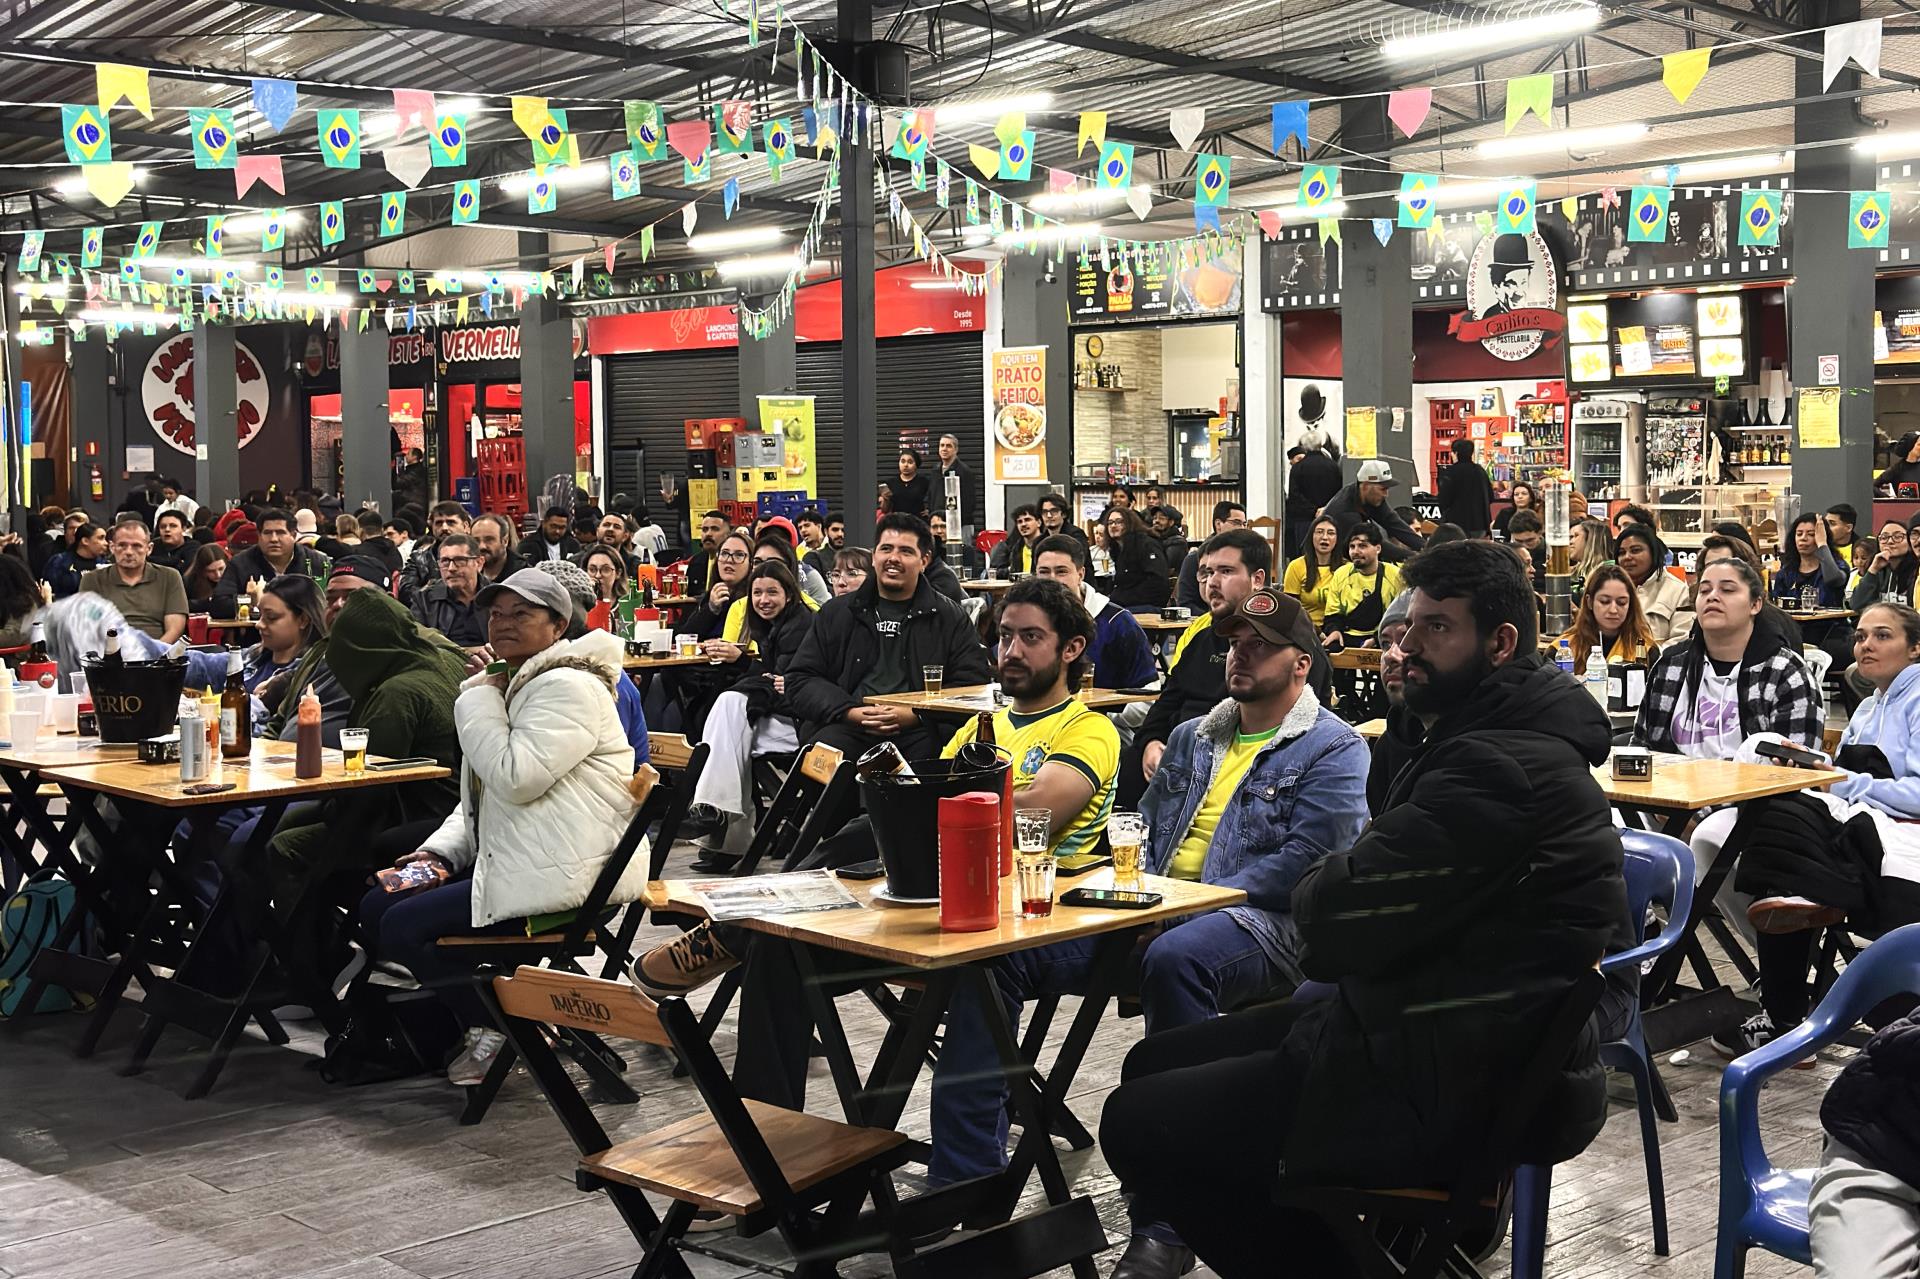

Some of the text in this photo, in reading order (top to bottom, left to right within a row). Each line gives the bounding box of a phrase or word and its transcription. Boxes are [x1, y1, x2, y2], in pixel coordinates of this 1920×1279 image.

[953, 310, 972, 318] Desde
[705, 323, 738, 333] LANCHONET
[442, 326, 521, 362] VERMELH
[1497, 334, 1531, 344] PASTELARIA
[1022, 353, 1039, 364] TEM
[996, 366, 1042, 385] PRATO
[1000, 386, 1039, 406] FEITO
